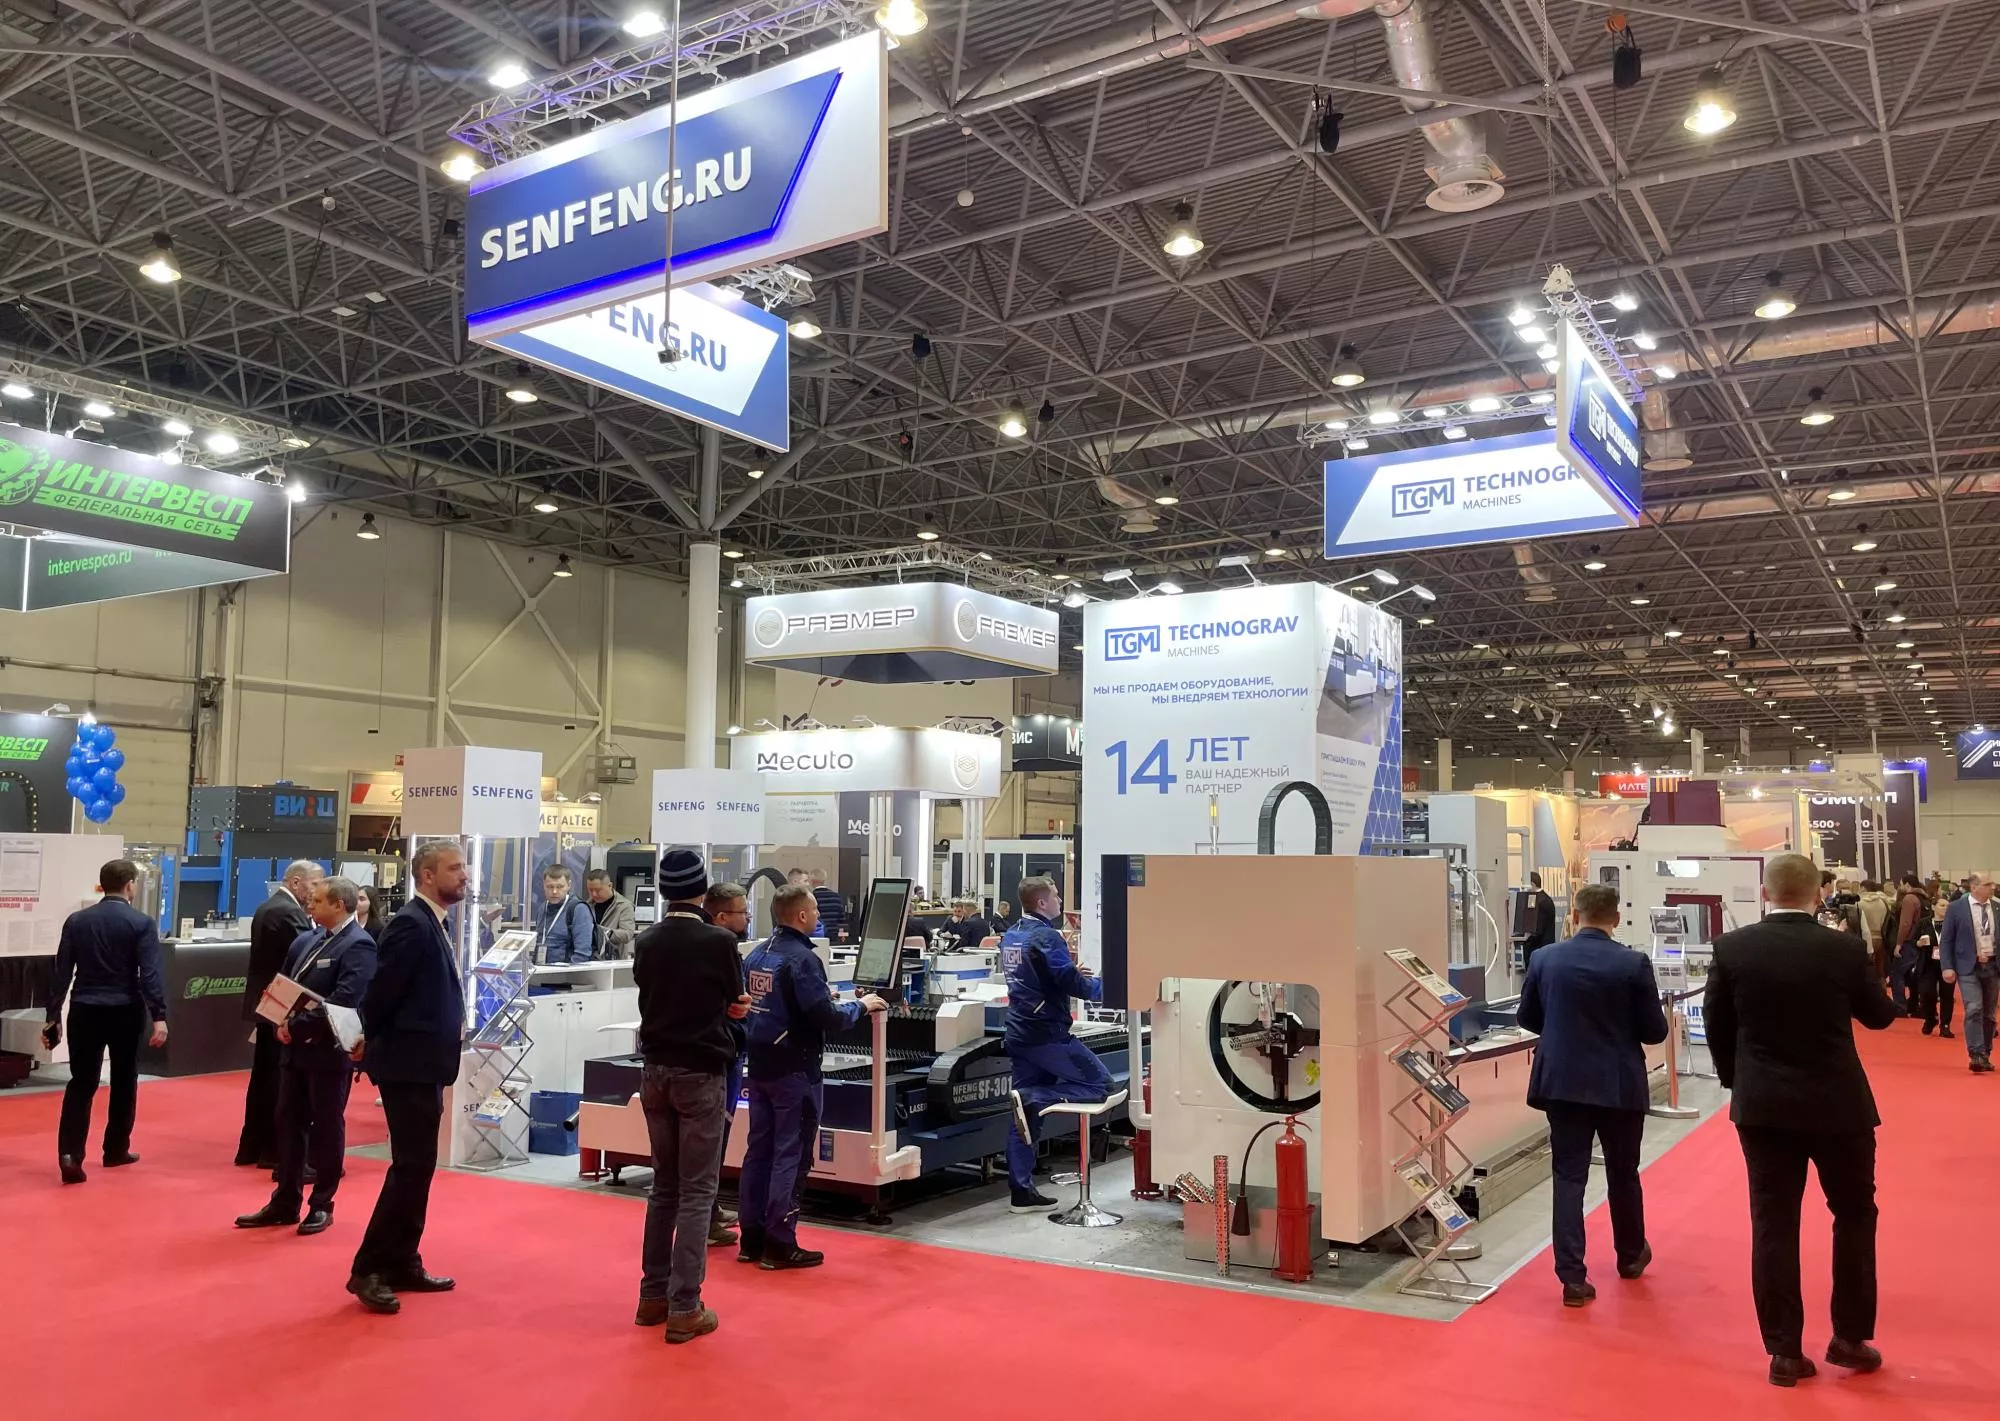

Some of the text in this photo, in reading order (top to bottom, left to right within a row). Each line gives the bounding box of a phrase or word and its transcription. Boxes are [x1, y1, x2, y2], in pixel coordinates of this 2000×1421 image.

[481, 146, 752, 269] SENFENG.RU
[46, 459, 254, 525] ИНТЕРВЕСП
[1396, 483, 1449, 512] TGM
[1463, 494, 1522, 511] MACHINES
[54, 493, 223, 535] ФЕДЕРАЛЬНАЯ СЕТЬ
[48, 549, 133, 578] intervespco.ru
[787, 608, 915, 635] РАЗМЕР
[978, 616, 1056, 648] РАЗМЕР
[1108, 615, 1299, 657] TGM TECHNOGRAV
[1167, 644, 1220, 660] MACHINES
[1093, 676, 1274, 695] МЫ НЕ ПРОДАЕМ ОБОРУДОВАНИЕ,
[1152, 687, 1309, 705] МЫ ВНЕДРЯЕМ ТЕХНОЛОГИИ
[757, 750, 854, 772] Mecuto
[1105, 736, 1250, 796] 14 ЛЕТ
[1186, 765, 1290, 781] ВАШ НАДЕЖНЫЙ
[409, 785, 458, 798] SENFENG
[472, 785, 534, 800] SENFENG
[1186, 783, 1242, 796] ПАРТНЕР
[658, 800, 705, 811] SENFENG
[716, 800, 760, 813] SENFENG
[750, 972, 772, 993] TGM
